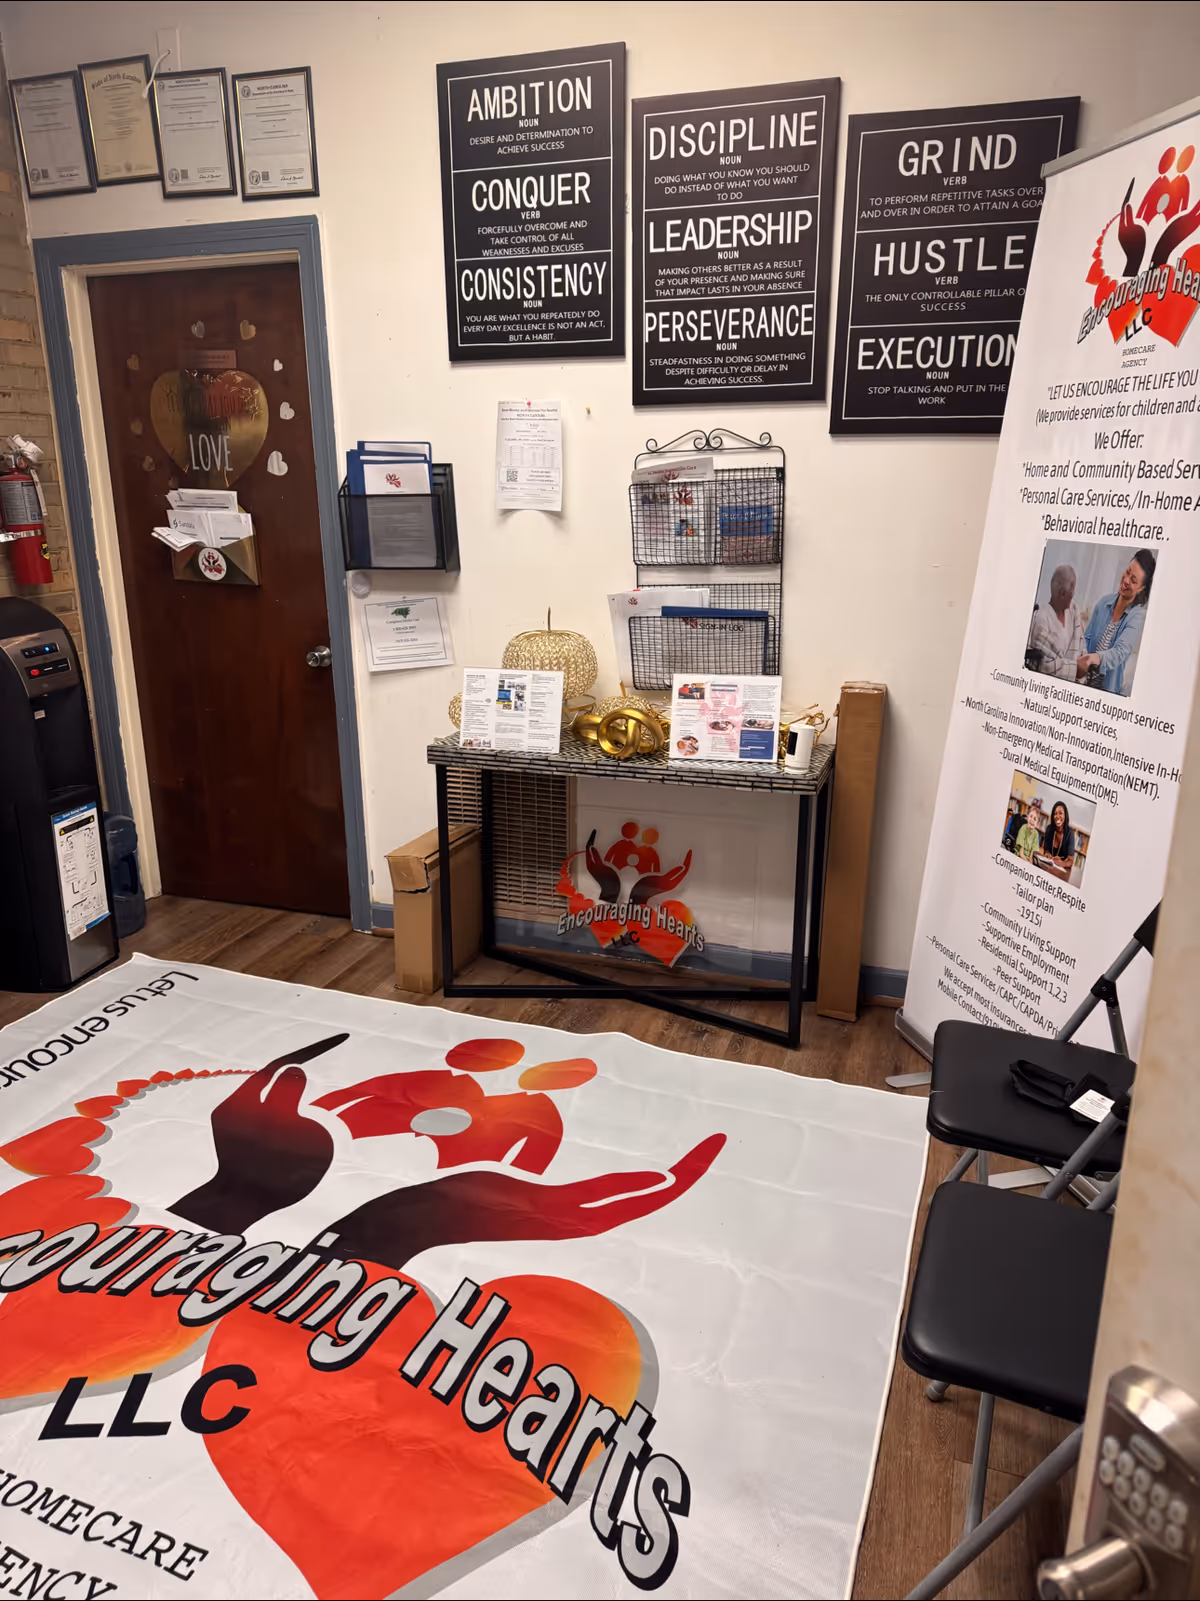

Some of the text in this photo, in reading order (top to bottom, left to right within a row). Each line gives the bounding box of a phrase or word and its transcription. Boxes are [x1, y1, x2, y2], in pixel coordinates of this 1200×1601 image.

[467, 76, 591, 122] AMBITION
[519, 118, 539, 128] NOUN
[470, 126, 593, 145] DESIRE AND DETERMINATION TO
[650, 111, 817, 160] DISCIPLINE
[497, 141, 565, 154] ACHIEVE SUCCESS
[899, 134, 1017, 176] GRIND
[720, 155, 742, 165] NOUN
[655, 164, 810, 184] DOING WHAT YOU KNOW YOU SHOULD
[679, 184, 712, 193] INSTEAD
[714, 182, 725, 190] OF
[727, 180, 751, 189] WHAT
[753, 178, 771, 186] YOU
[773, 176, 798, 185] WANT
[943, 176, 967, 185] VERB
[472, 172, 591, 212] CONQUER
[521, 211, 541, 219] VERB
[650, 210, 812, 253] LEADERSHIP
[718, 251, 739, 259] NOUN
[874, 235, 1026, 276] HUSTLE
[461, 261, 606, 301] CONSISTENCY
[935, 276, 958, 285] VERB
[523, 300, 542, 308] NOUN
[1077, 262, 1171, 344] Encouraging
[541, 311, 586, 319] REPEATEDLY
[645, 304, 813, 343] PERSEVERANCE
[1125, 308, 1152, 341] LLC
[716, 343, 737, 351] NOUN
[857, 334, 1017, 370] EXECUTION
[649, 357, 712, 366] STEADFASTNESS
[726, 355, 753, 363] DOING
[755, 353, 806, 362] SOMETHING
[697, 366, 739, 375] DIFFICULTY
[740, 365, 752, 373] OR
[754, 364, 777, 372] DELAY
[1121, 358, 1147, 368] AGENCY
[684, 375, 764, 385] ACHIEVING SUCCESS.
[926, 371, 949, 379] NOUN
[1063, 384, 1075, 398] US
[1076, 377, 1131, 398] ENCOURAGE
[1133, 374, 1152, 392] THE
[1152, 372, 1176, 390] LIFE
[1177, 369, 1199, 387] YOU
[893, 386, 930, 394] TALKING
[933, 385, 954, 393] AND
[1049, 406, 1080, 425] provide
[1080, 404, 1115, 420] services
[1116, 401, 1131, 417] for
[1131, 398, 1175, 416] children
[1176, 395, 1196, 413] and
[1094, 432, 1109, 449] We
[189, 434, 233, 472] LOVE
[1050, 460, 1070, 478] and
[1073, 460, 1136, 483] Community
[1137, 459, 1175, 479] Based
[1061, 488, 1084, 506] Care
[984, 702, 1007, 722] Carolina
[1050, 686, 1084, 706] Facilities
[1085, 699, 1102, 712] and
[1101, 702, 1133, 722] support
[1134, 713, 1175, 735] services
[1051, 706, 1083, 728] Support
[1035, 740, 1064, 762] Medical
[1023, 756, 1050, 777] Medical
[1036, 898, 1054, 915] plan
[557, 899, 704, 952] Encouraging Hearts
[611, 930, 640, 949] LLC
[1023, 926, 1045, 952] Living
[1045, 940, 1077, 969] Support
[1021, 945, 1070, 985] Employment
[1019, 962, 1048, 992] Support
[1012, 977, 1041, 1005] Support
[0, 971, 199, 1090] Let us encour
[38, 1365, 258, 1439] LLC
[400, 1277, 690, 1590] Hearts
[0, 1541, 118, 1600] ENCY
